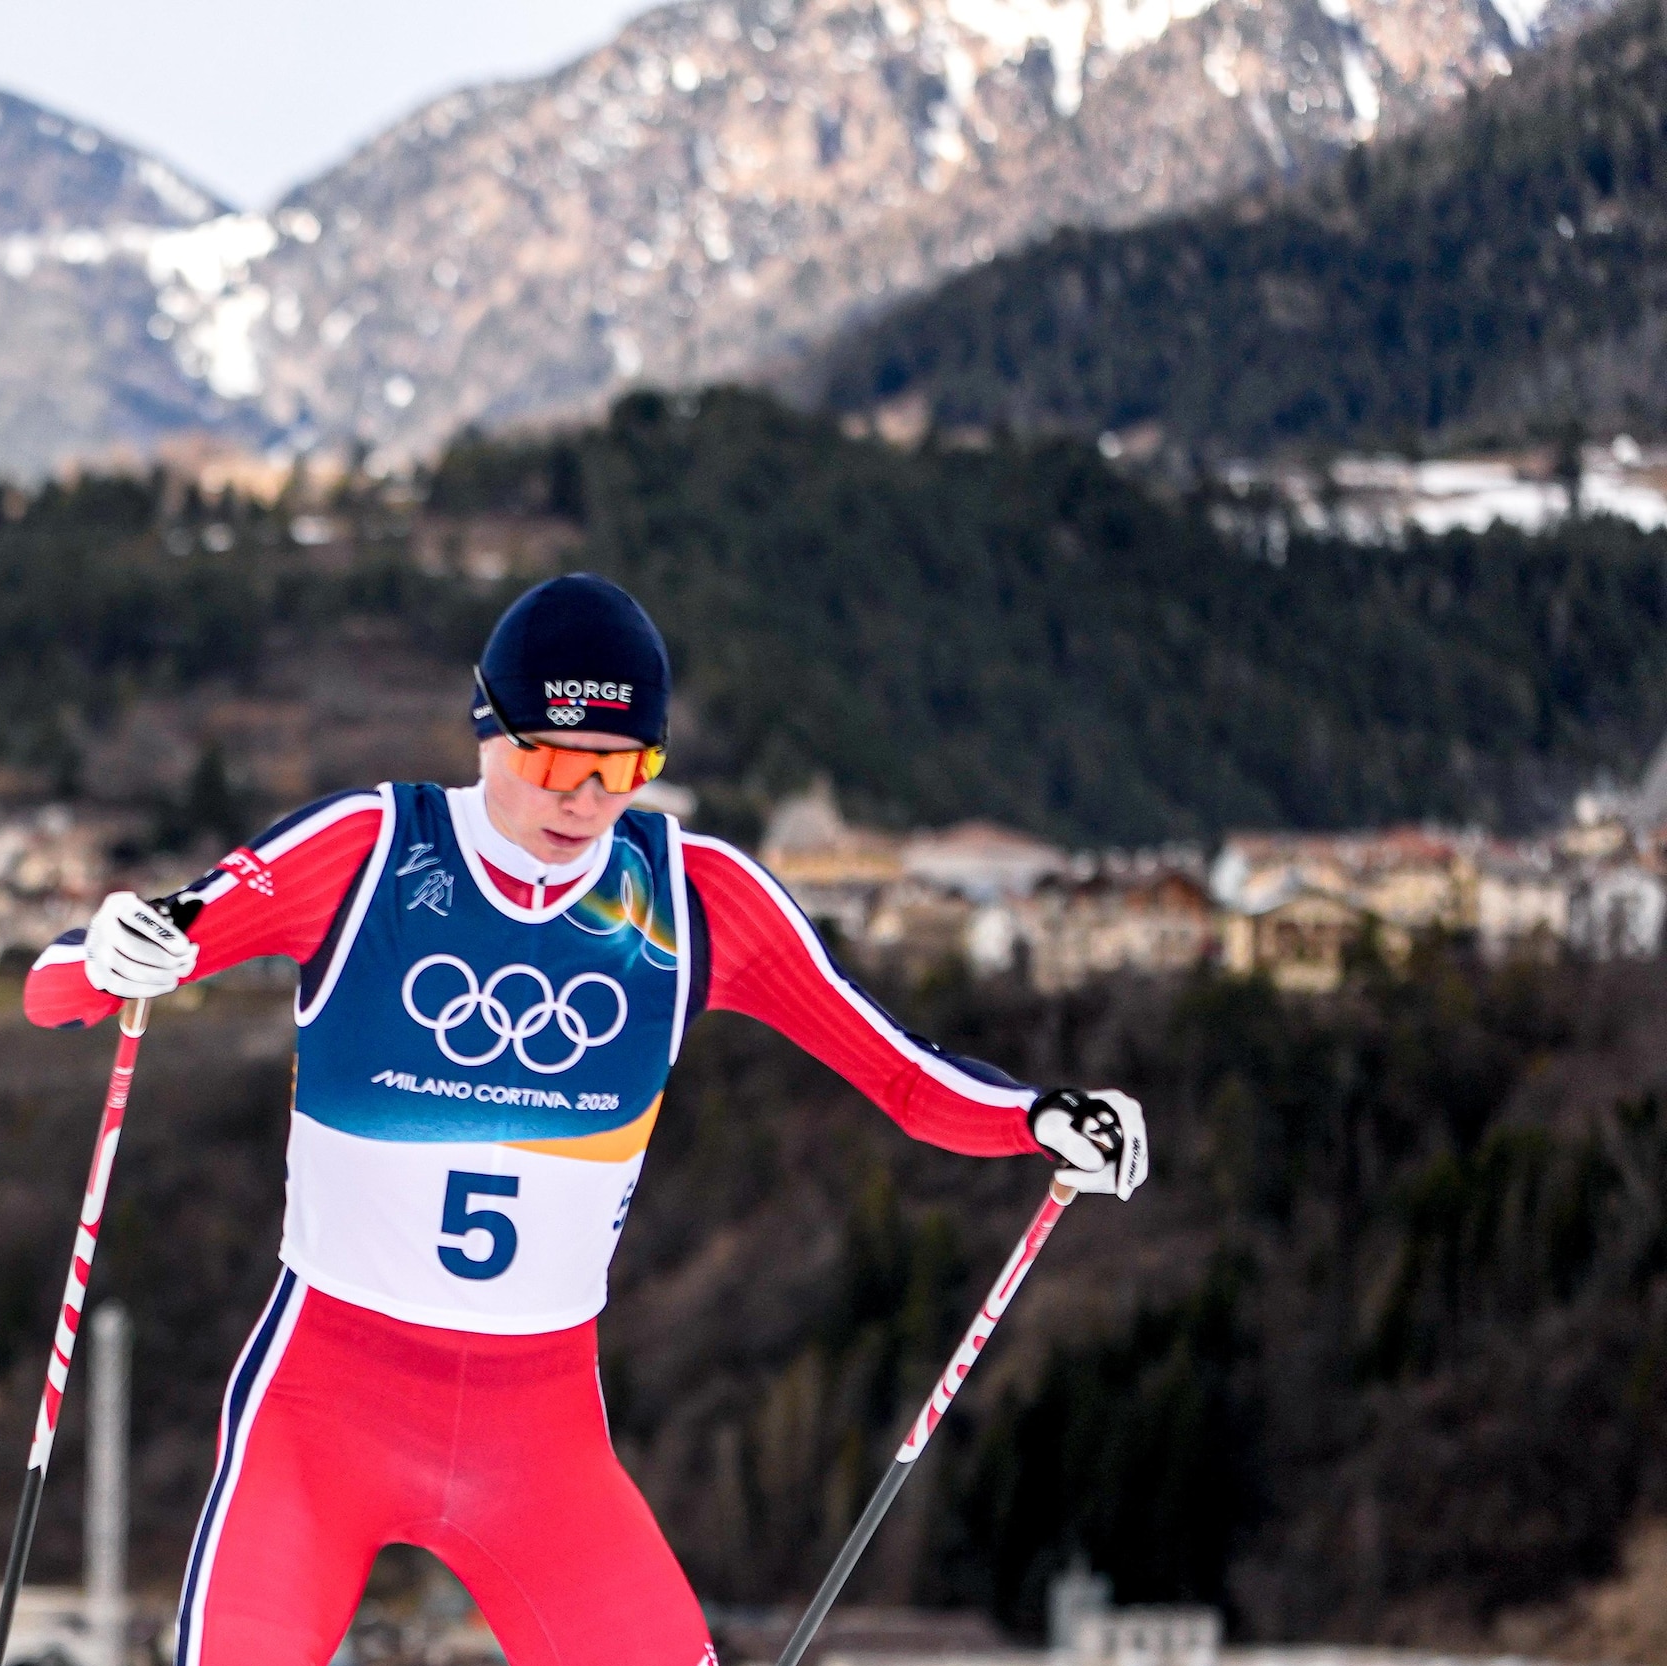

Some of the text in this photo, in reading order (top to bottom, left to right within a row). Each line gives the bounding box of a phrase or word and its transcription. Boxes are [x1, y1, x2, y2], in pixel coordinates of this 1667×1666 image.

[544, 679, 634, 703] NORGE
[371, 1069, 620, 1111] MILANO CORTINA 2026
[436, 1170, 521, 1282] 5
